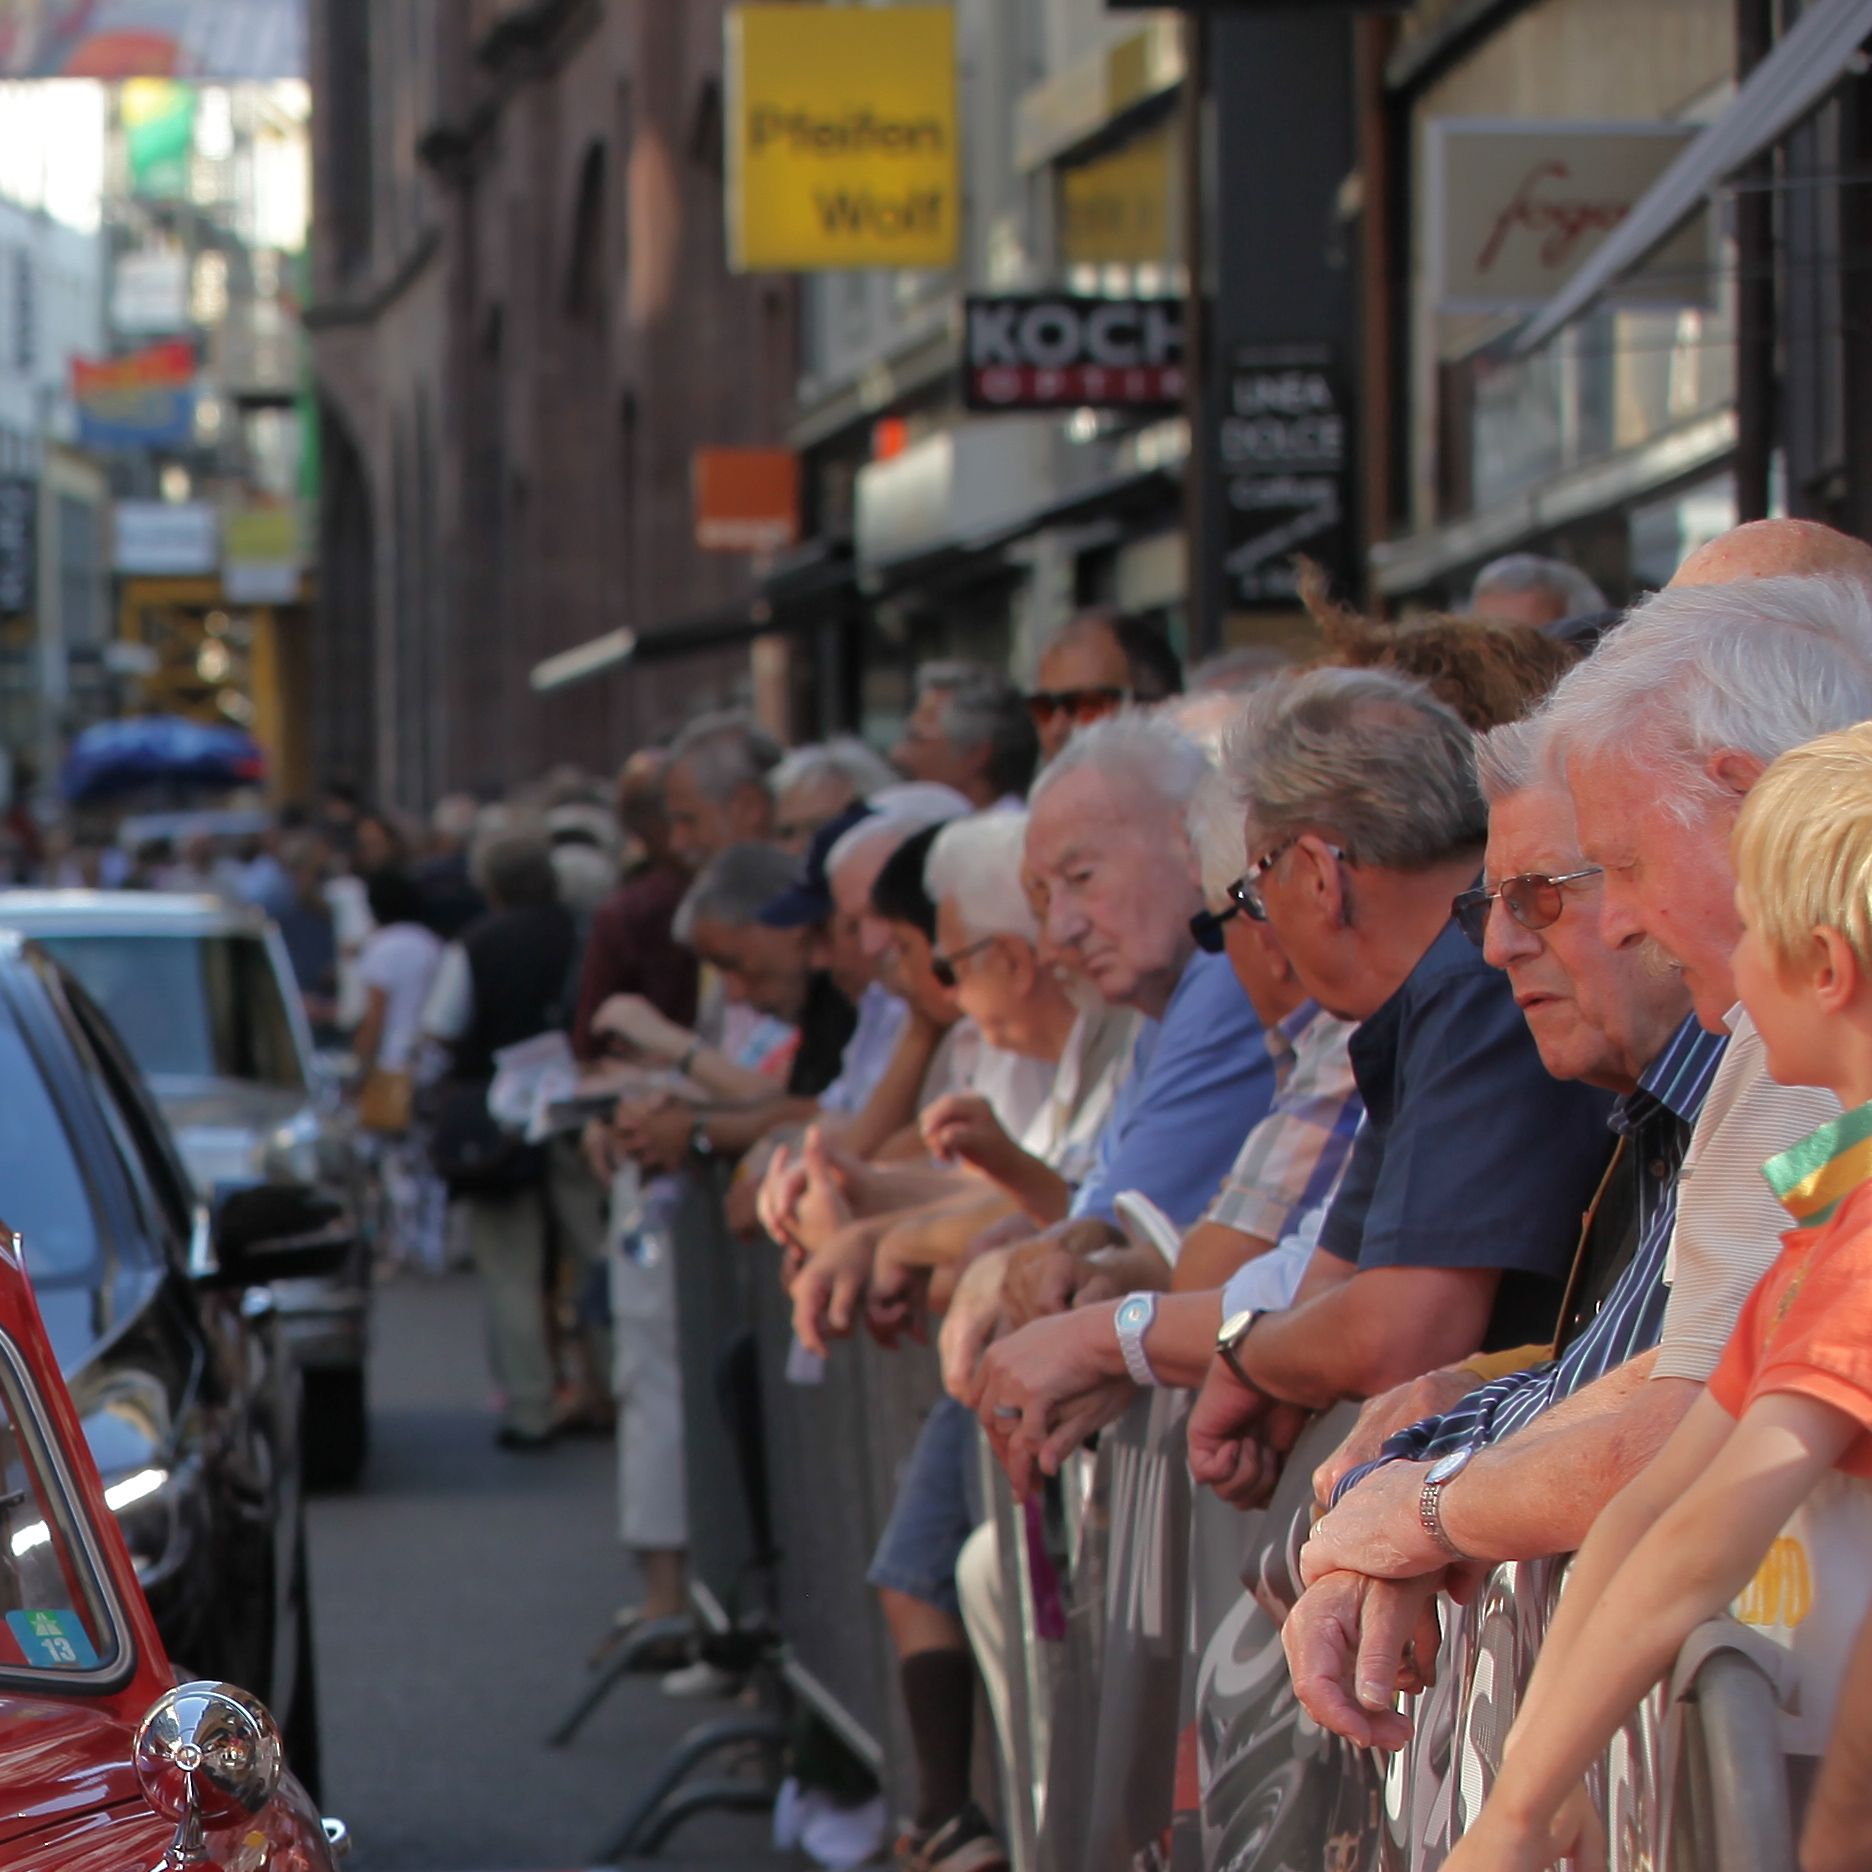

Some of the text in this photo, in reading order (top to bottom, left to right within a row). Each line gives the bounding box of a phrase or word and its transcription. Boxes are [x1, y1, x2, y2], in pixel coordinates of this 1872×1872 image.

[751, 103, 943, 157] Pfeifen
[813, 187, 943, 238] Wolf
[41, 1637, 76, 1662] 13
